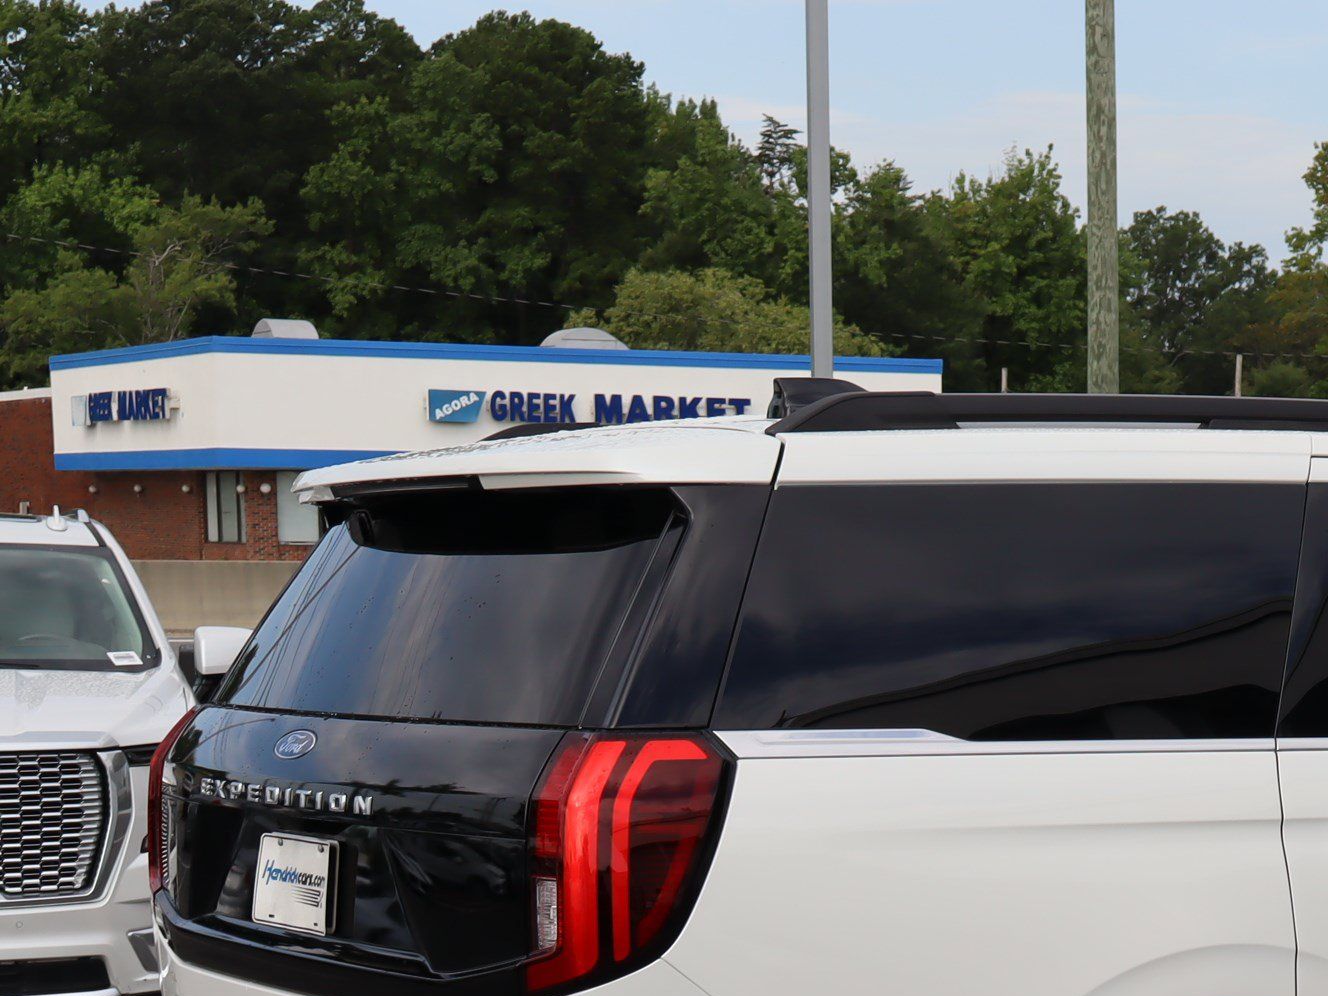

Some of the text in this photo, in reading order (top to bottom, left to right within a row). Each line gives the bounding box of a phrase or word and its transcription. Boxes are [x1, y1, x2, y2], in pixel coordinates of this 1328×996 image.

[434, 389, 751, 425] AGORA GREEK MARKET
[278, 733, 312, 755] Ford
[200, 777, 373, 816] EXPEDITION
